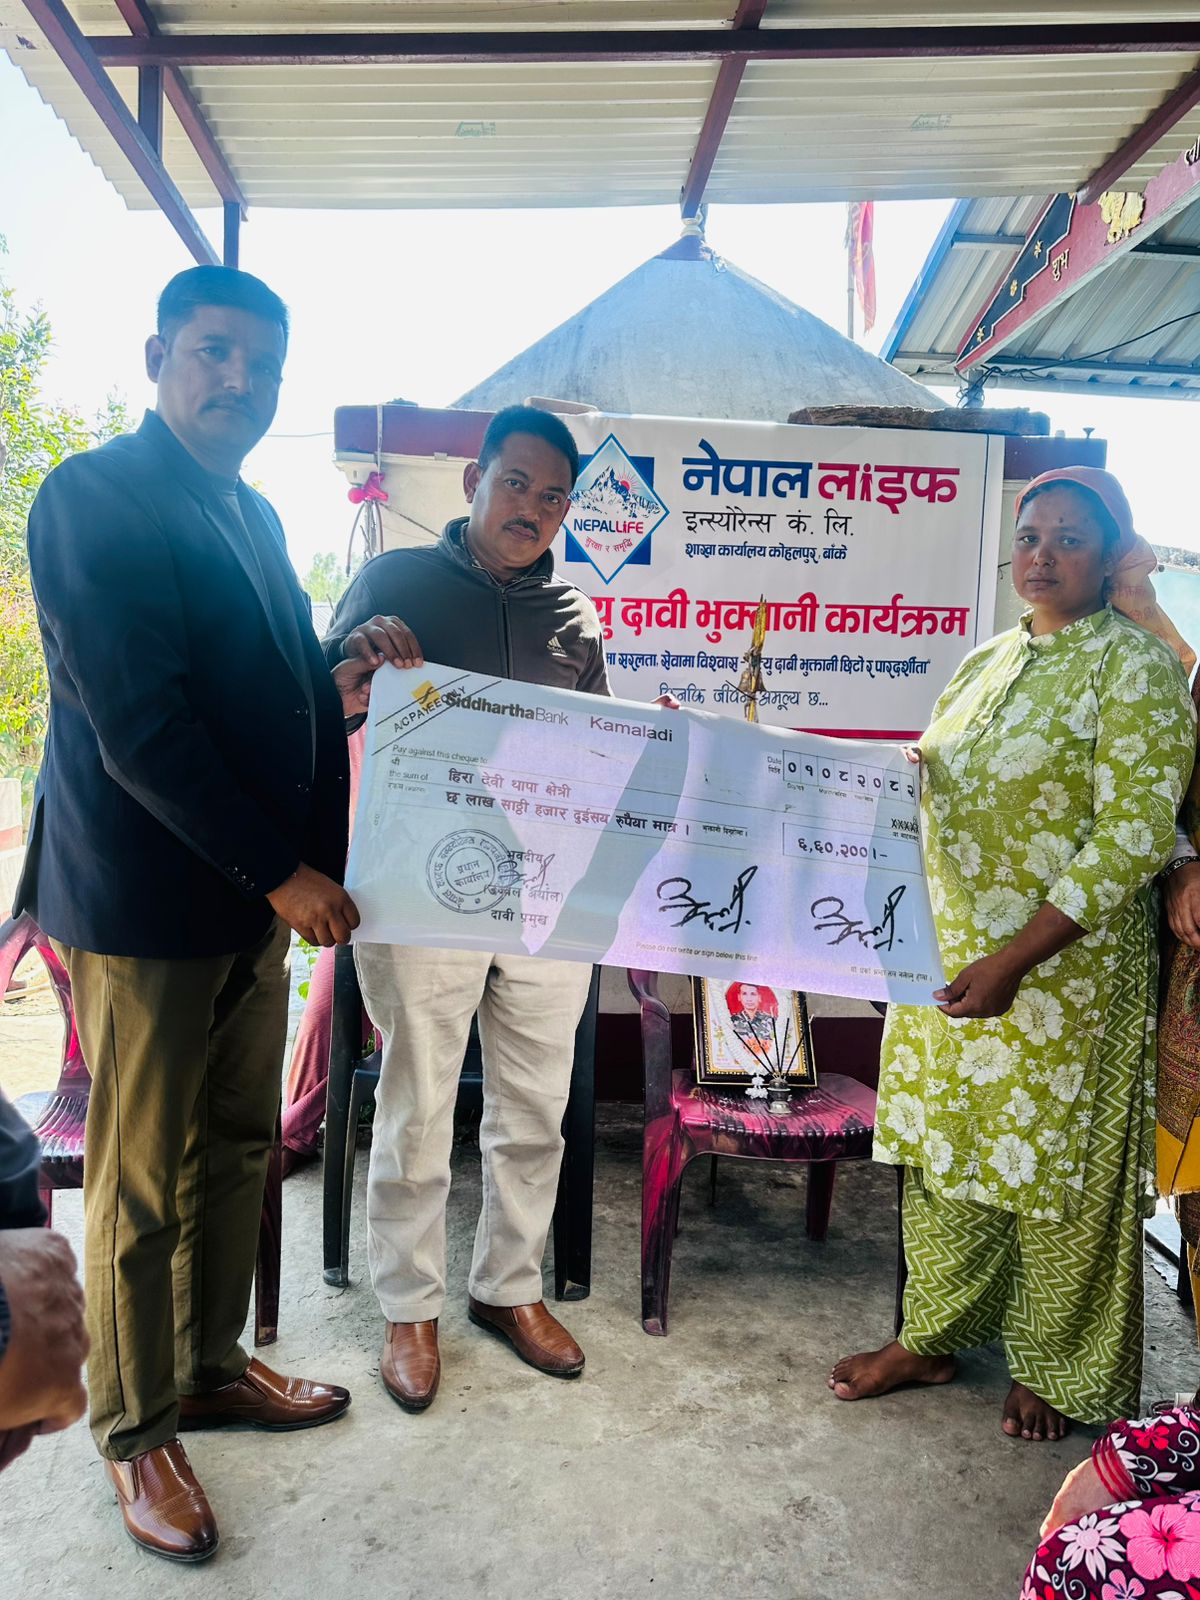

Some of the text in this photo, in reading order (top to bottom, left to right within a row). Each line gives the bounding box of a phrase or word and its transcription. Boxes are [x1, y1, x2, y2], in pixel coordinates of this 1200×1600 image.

[682, 438, 960, 514] नेपाल लाइफ
[682, 506, 776, 534] इन्स्योरेन्स
[718, 542, 766, 559] कार्यालय
[621, 588, 690, 636] दावी
[825, 594, 970, 638] कार्यक्रम
[661, 650, 695, 670] सेवामा
[697, 651, 738, 672] विश्वास
[800, 655, 838, 676] भुक्तानी
[840, 655, 864, 674] छिटो
[758, 690, 801, 710] अमूल्य
[590, 716, 673, 742] Kamaladi
[393, 744, 407, 755] Pay
[409, 747, 435, 759] against
[437, 749, 450, 760] this
[451, 751, 479, 764] cheque
[402, 772, 419, 780] sum
[420, 772, 429, 781] of
[448, 768, 572, 798] हिरा देवी थापा क्षेत्री
[446, 791, 460, 805] छ
[466, 792, 495, 809] लाख
[535, 804, 566, 821] हजार
[574, 807, 610, 826] दुईसय
[653, 820, 679, 834] मात्र
[454, 860, 491, 887] प्रधान कार्यालय
[491, 909, 549, 928] दावी प्रमुख
